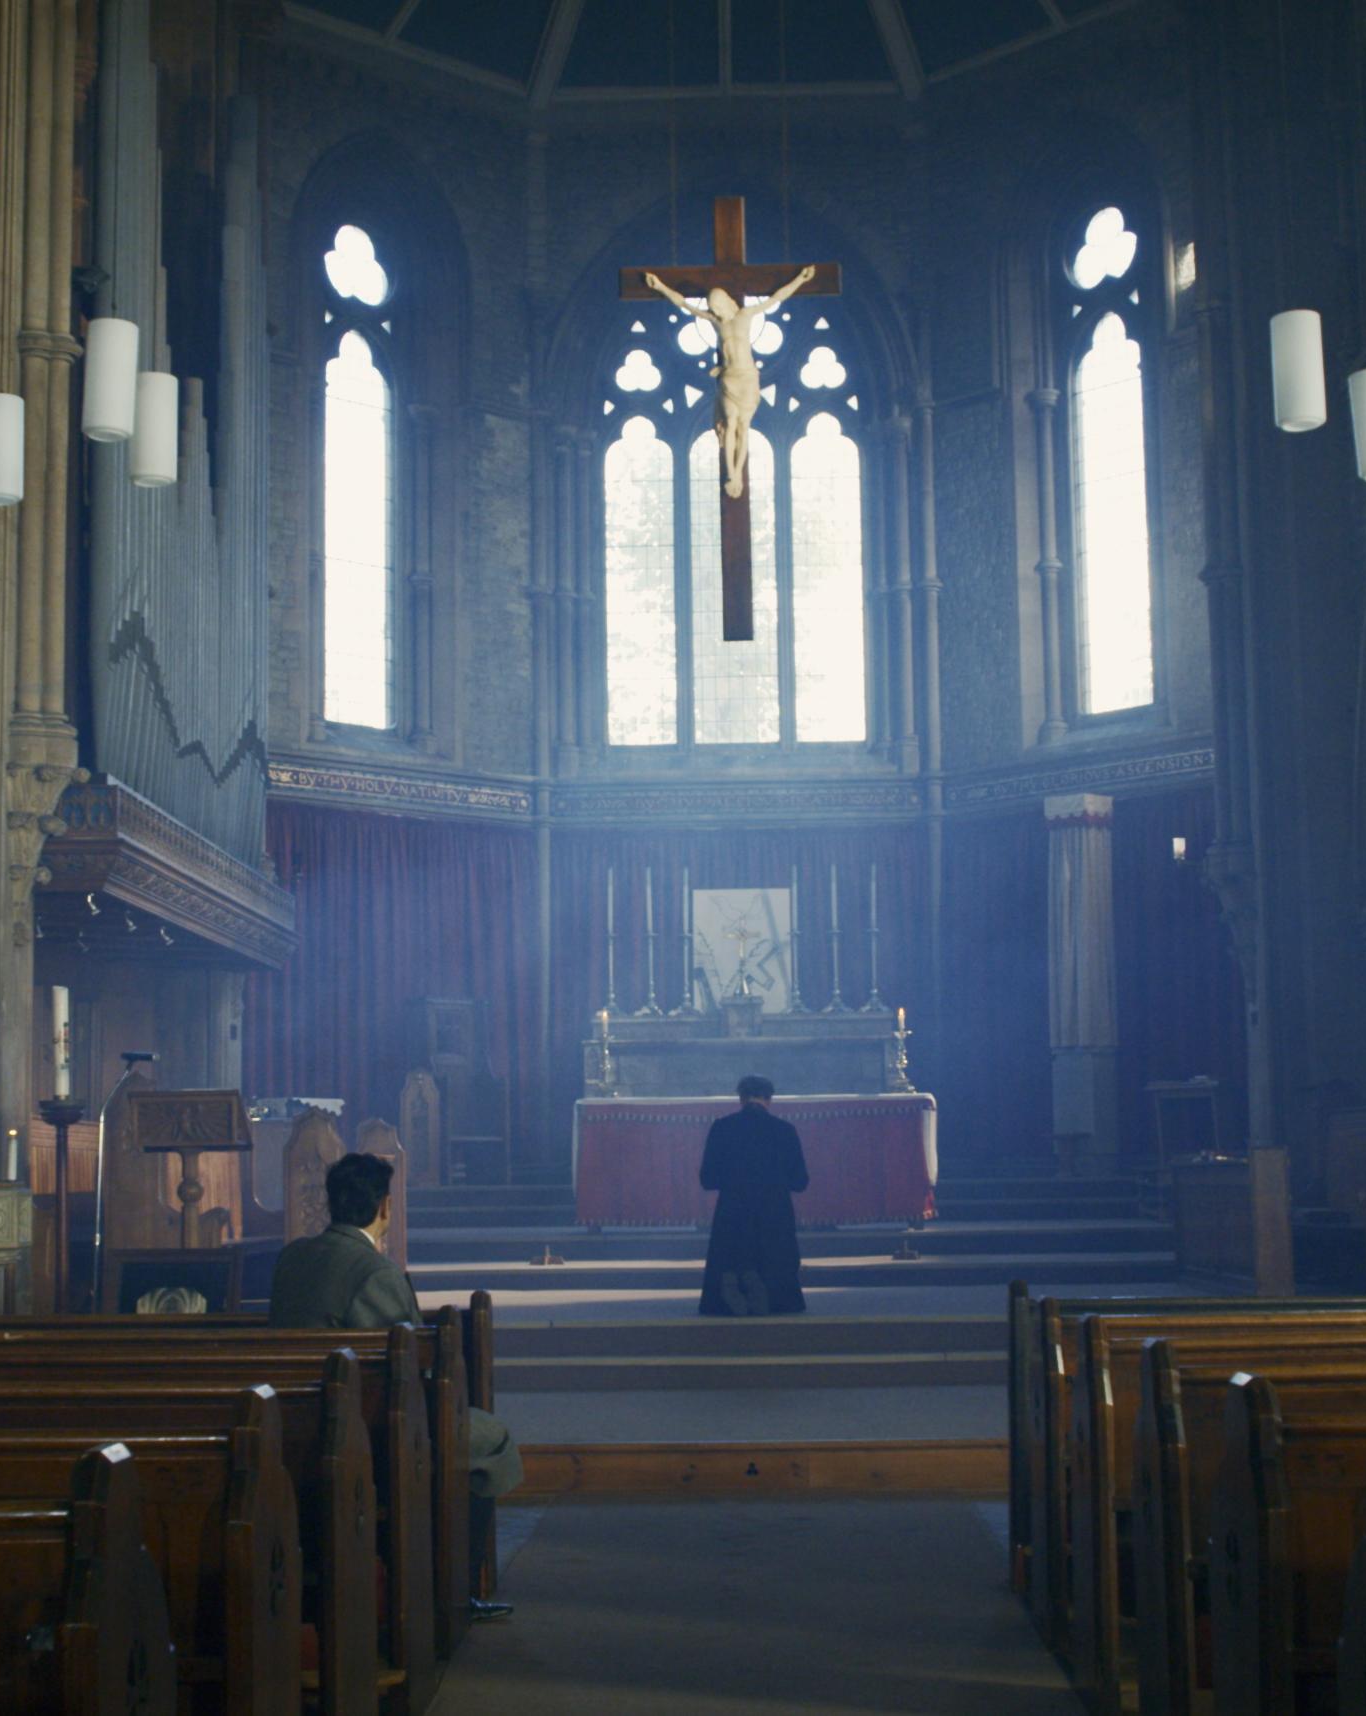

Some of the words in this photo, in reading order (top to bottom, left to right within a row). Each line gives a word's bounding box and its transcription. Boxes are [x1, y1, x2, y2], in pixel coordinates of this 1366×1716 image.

[1115, 753, 1204, 778] ASCENSION
[298, 772, 317, 787] BY
[322, 775, 352, 790] THY
[355, 780, 394, 795] HOLY
[399, 784, 464, 802] NATIVITY
